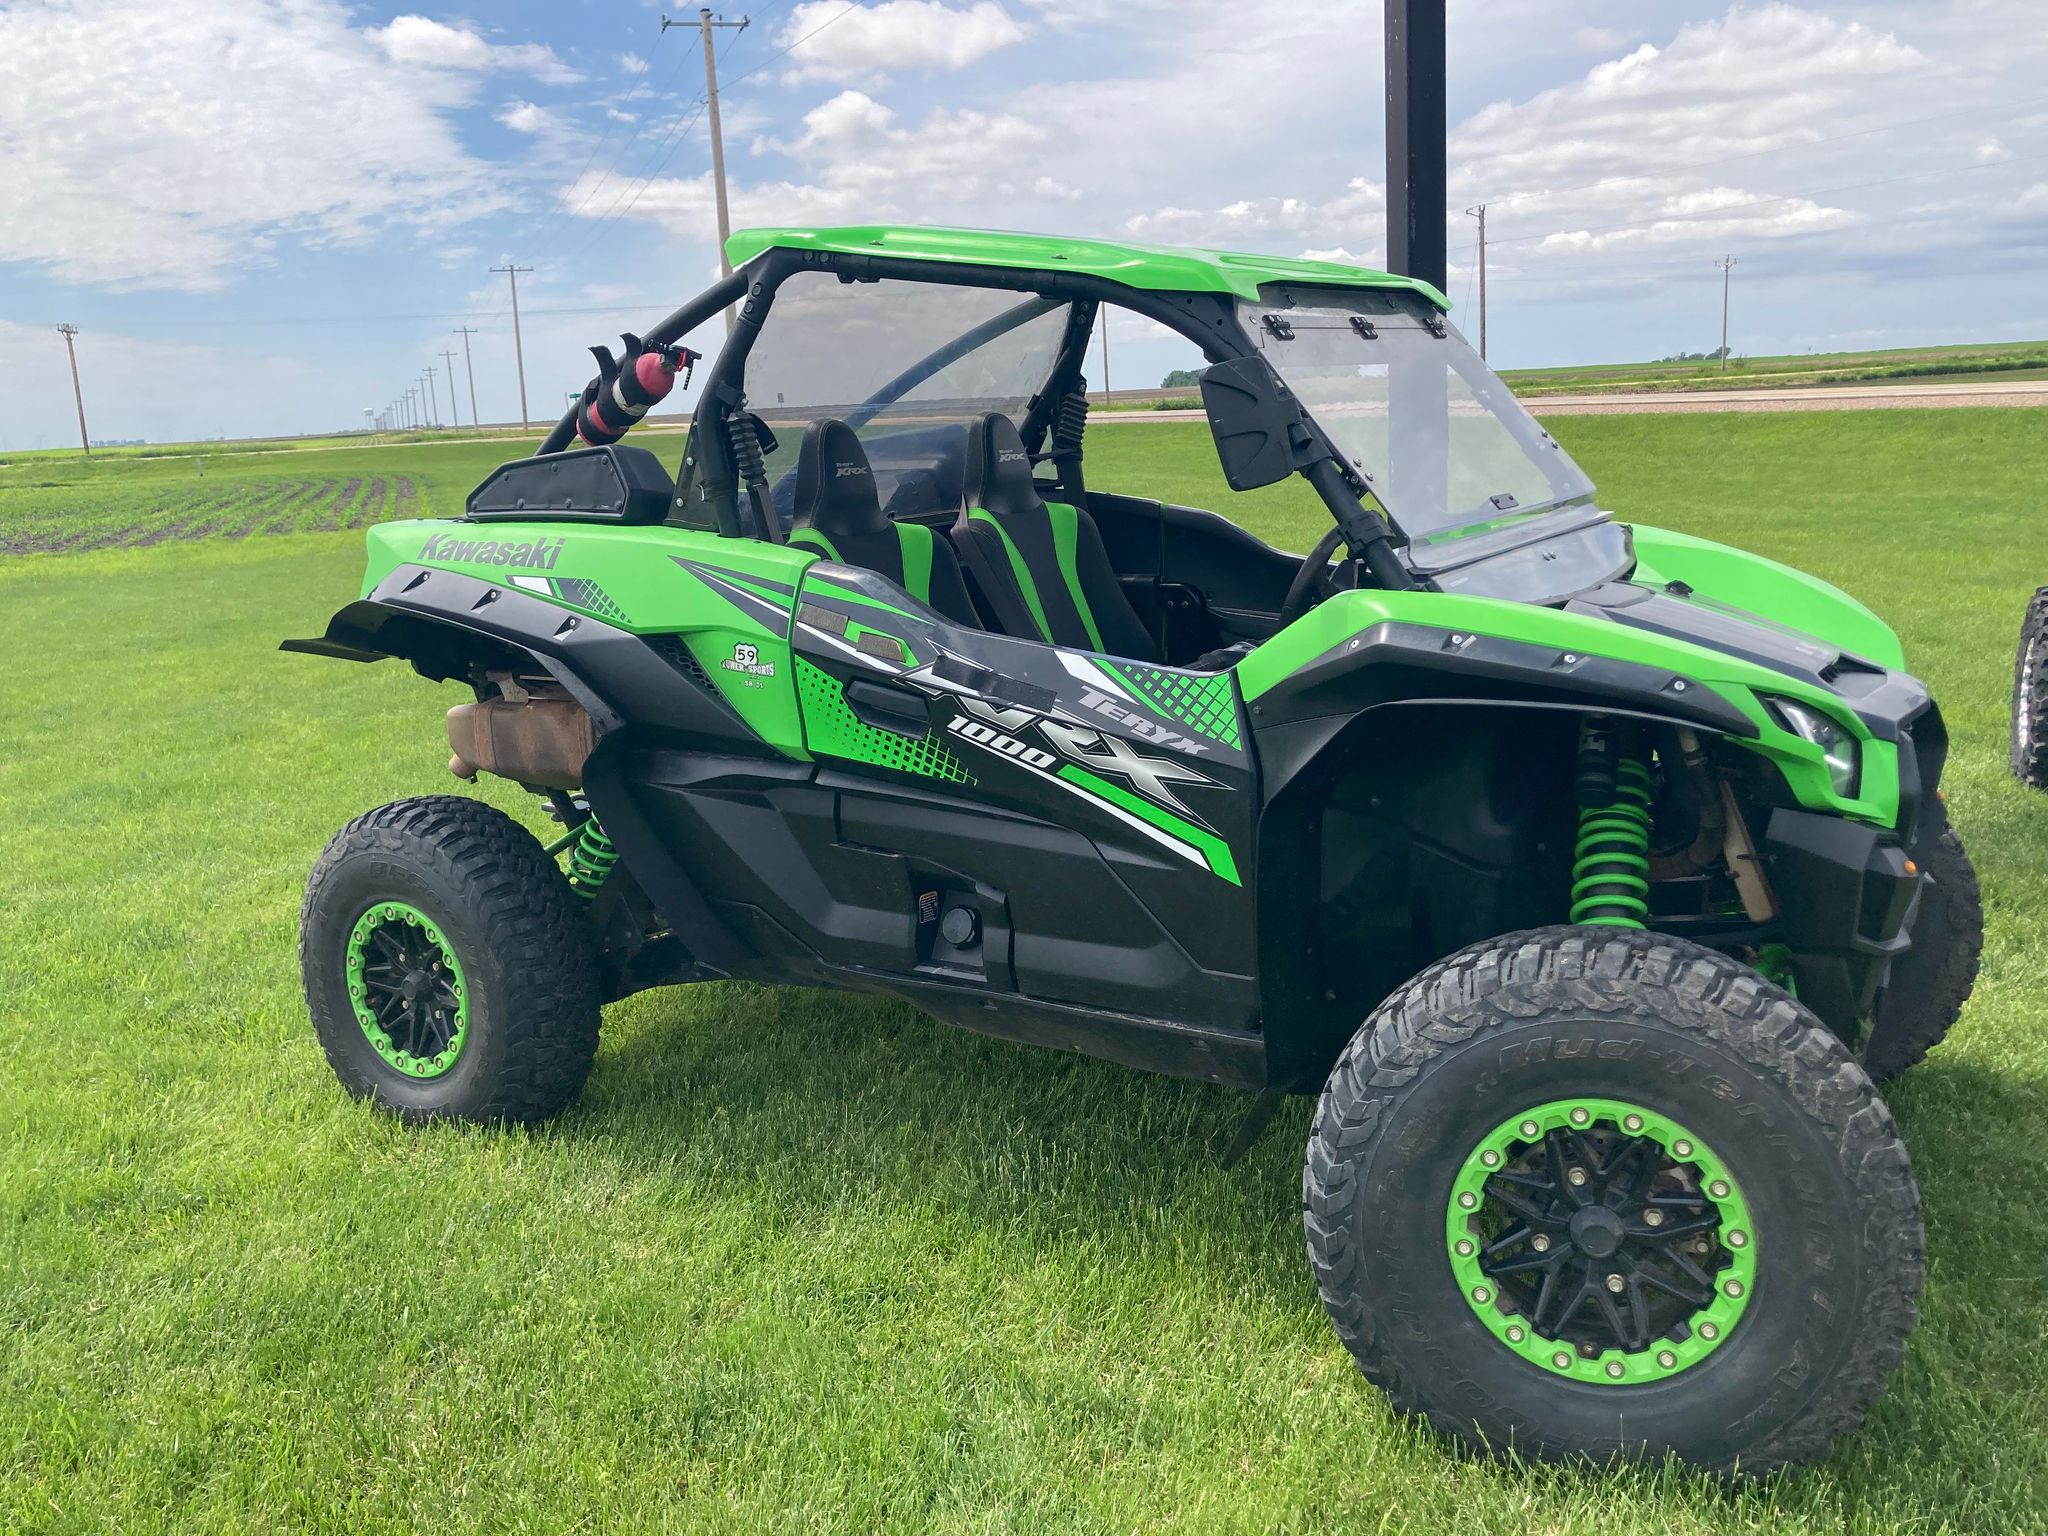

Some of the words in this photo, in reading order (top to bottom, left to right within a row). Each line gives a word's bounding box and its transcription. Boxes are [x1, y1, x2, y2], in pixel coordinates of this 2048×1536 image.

[999, 452, 1025, 463] KRX
[836, 466, 869, 477] KRX
[417, 533, 566, 570] Kawasaki
[738, 649, 755, 662] 59
[946, 713, 1057, 769] 1000
